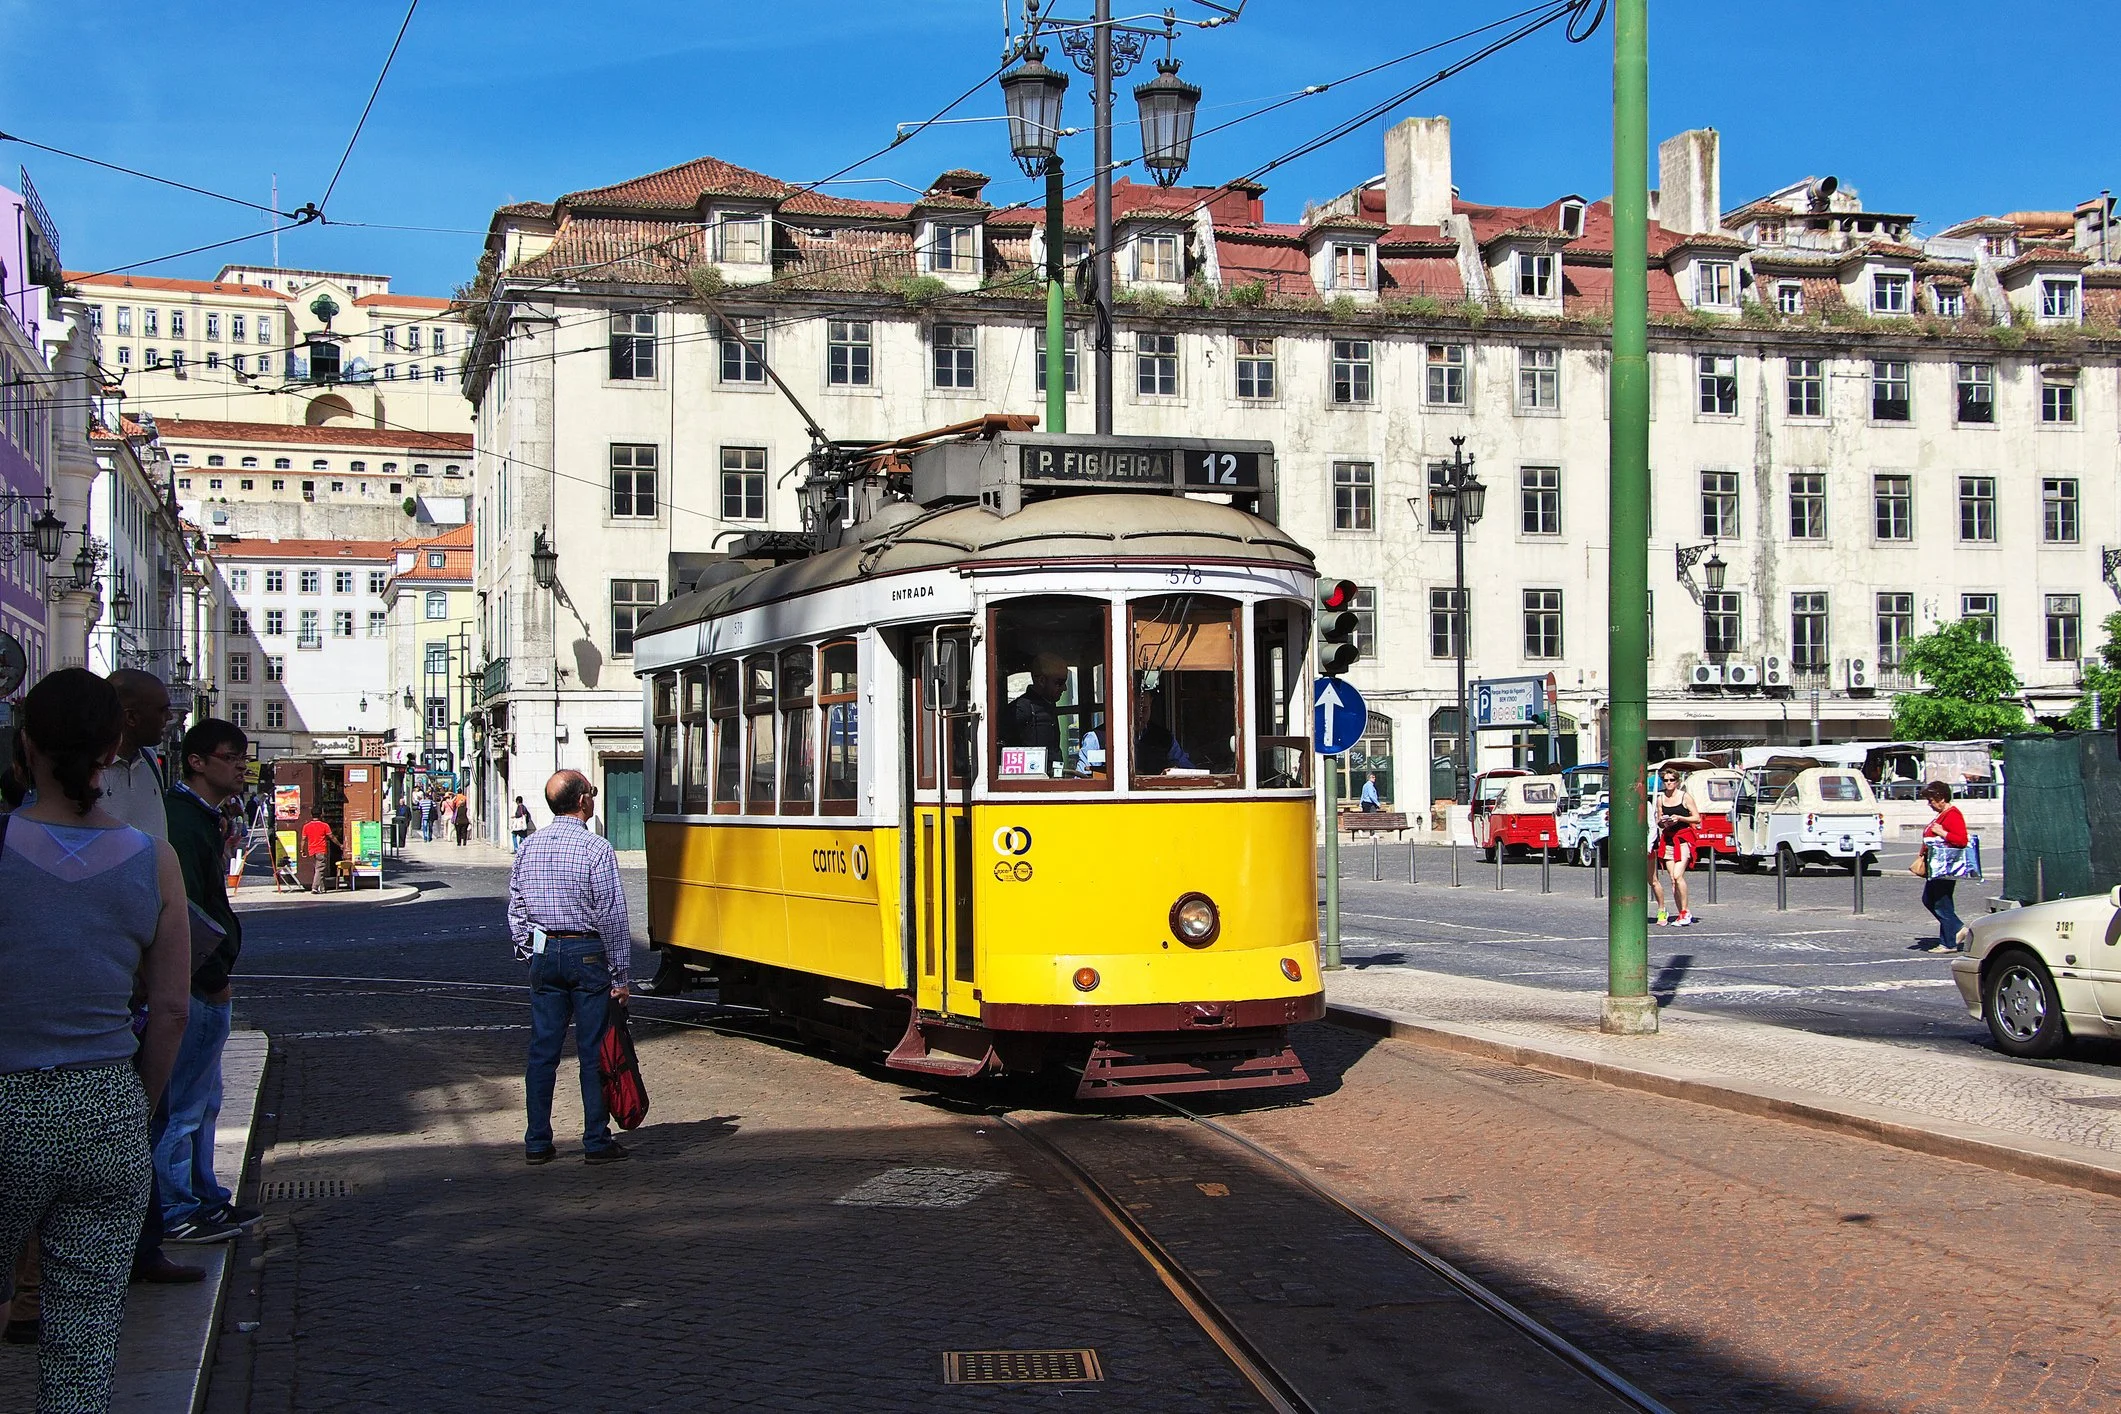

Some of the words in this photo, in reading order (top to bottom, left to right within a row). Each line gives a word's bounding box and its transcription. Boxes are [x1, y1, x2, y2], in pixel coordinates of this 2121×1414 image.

[1039, 450, 1055, 473] P.
[1063, 452, 1165, 477] FIGUEIRA
[1202, 453, 1238, 485] 12
[1170, 568, 1202, 585] 578
[892, 585, 934, 601] ENTRADA
[1006, 752, 1023, 765] 15E
[812, 839, 847, 875] carris
[2055, 921, 2074, 932] 3181
